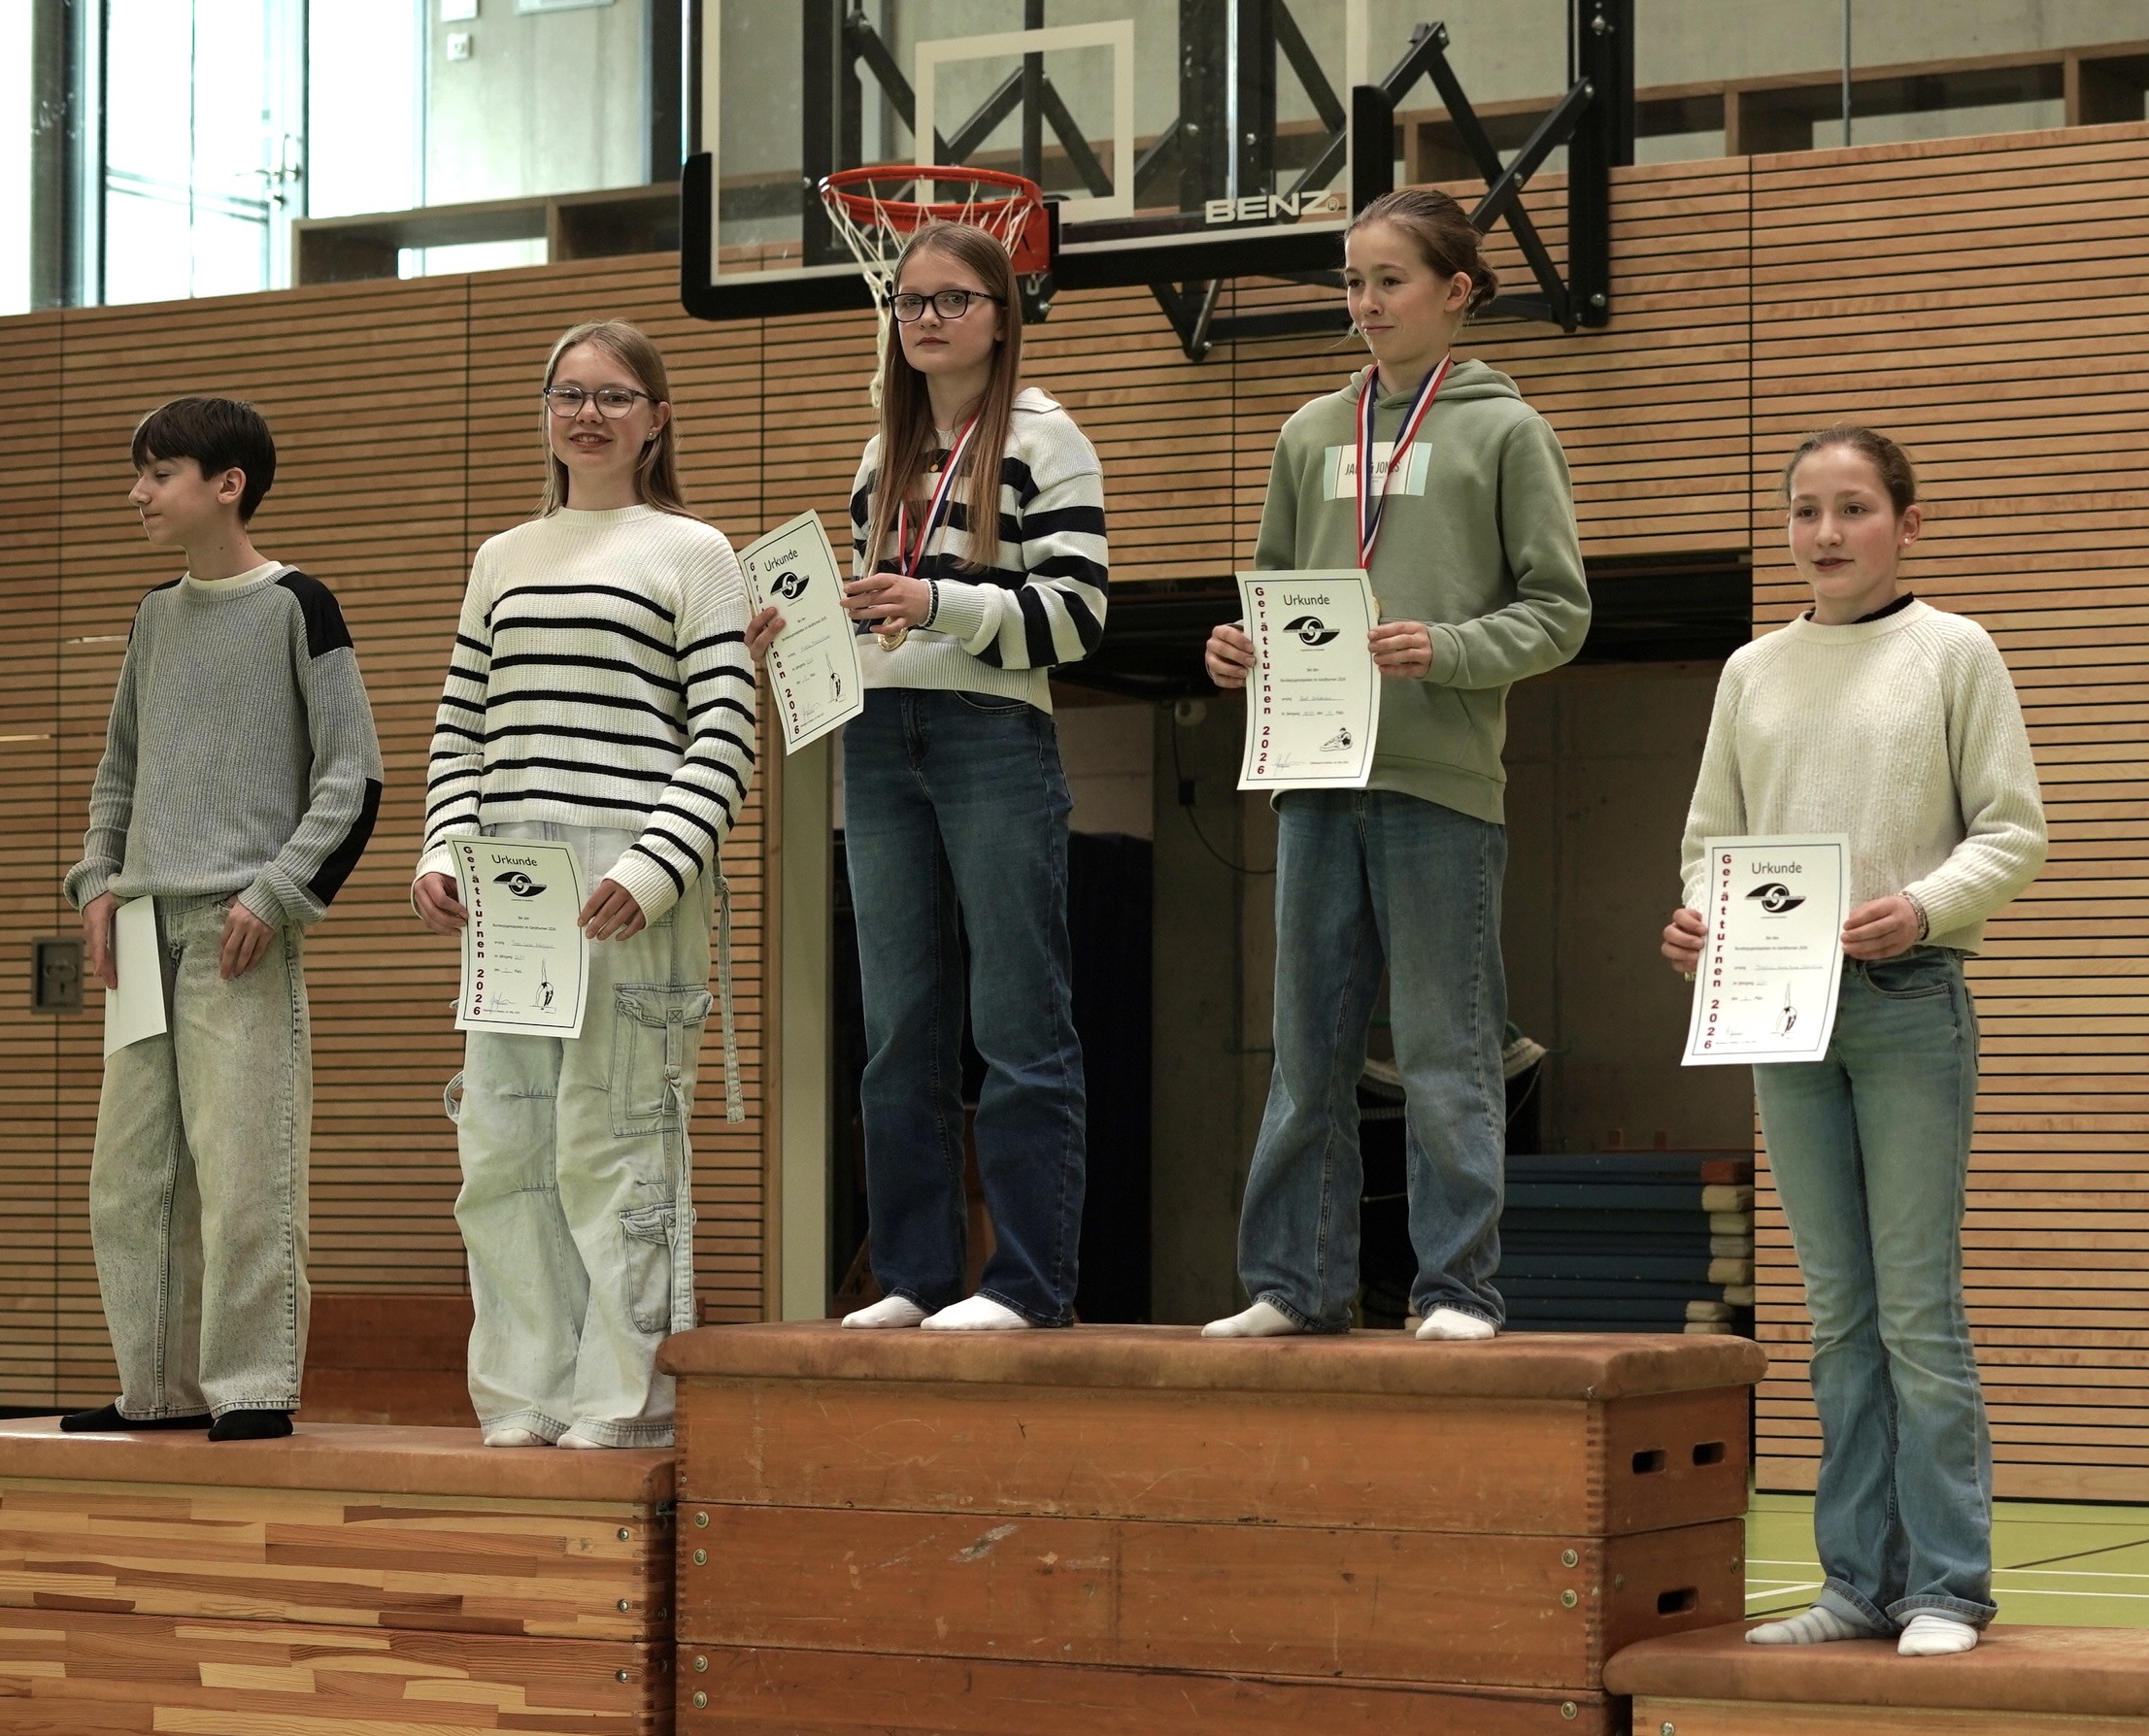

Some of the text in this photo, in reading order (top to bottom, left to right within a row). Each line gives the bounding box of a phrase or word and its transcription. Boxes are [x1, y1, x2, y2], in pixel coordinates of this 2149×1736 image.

[764, 549, 799, 572] Urkunde
[1283, 594, 1330, 606] Urkunde
[1255, 586, 1271, 775] Gerätturnen 2026
[785, 687, 800, 735] 2026
[491, 853, 538, 867] Urkunde
[1752, 861, 1802, 875] Urkunde
[463, 846, 485, 1016] Gerätturnen 2026
[1704, 853, 1731, 1049] Gerätturnen 2026
